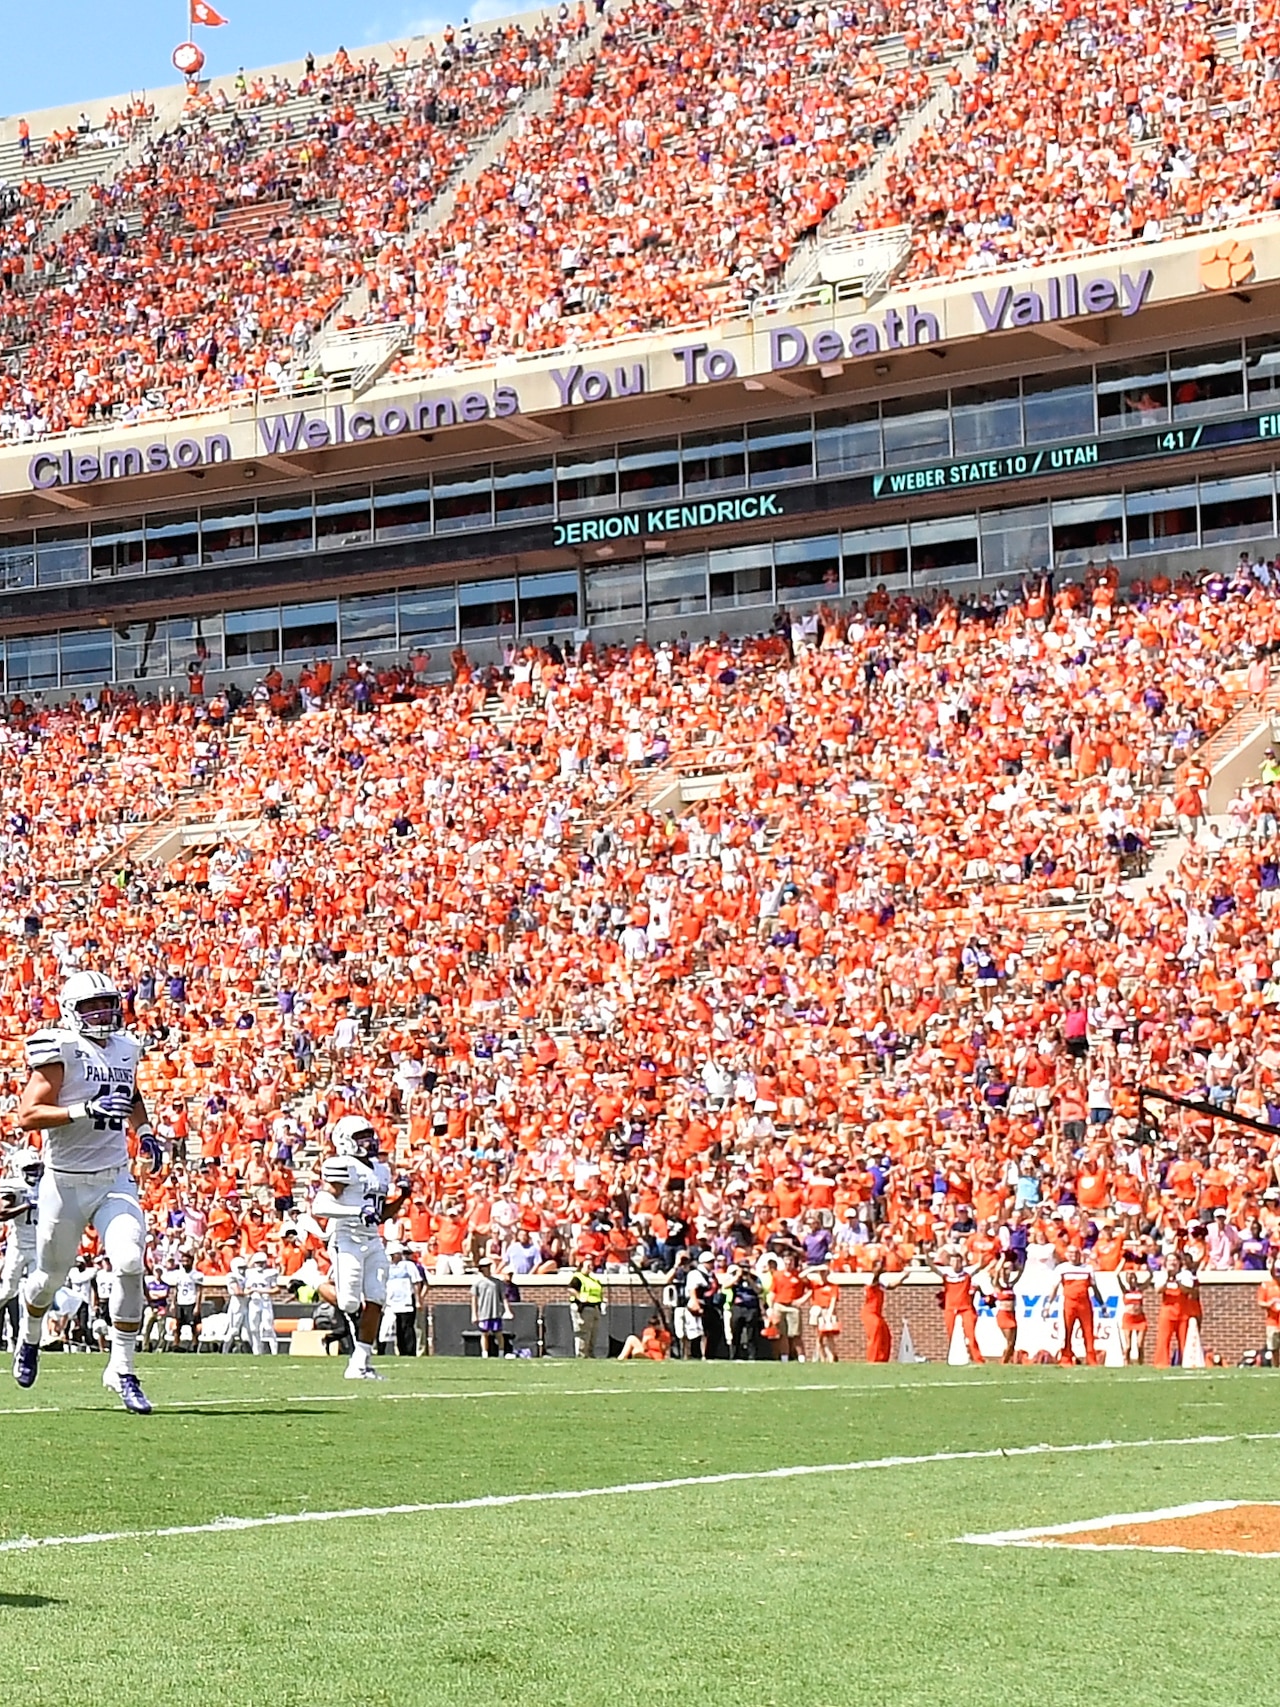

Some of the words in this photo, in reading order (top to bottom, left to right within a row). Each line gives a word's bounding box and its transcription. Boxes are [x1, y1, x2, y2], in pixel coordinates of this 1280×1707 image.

[28, 430, 232, 490] Clemson
[258, 379, 520, 455] Welcomes
[549, 361, 646, 406] You
[673, 343, 737, 385] To
[770, 304, 940, 372] Death
[973, 269, 1154, 331] Valley
[890, 469, 946, 492] WEBER
[950, 459, 1000, 483] STATE
[1006, 456, 1028, 475] 10
[1051, 445, 1099, 468] UTAH
[1162, 431, 1185, 450] 41
[1258, 413, 1280, 437] FI
[647, 493, 784, 533] KENDRICK.
